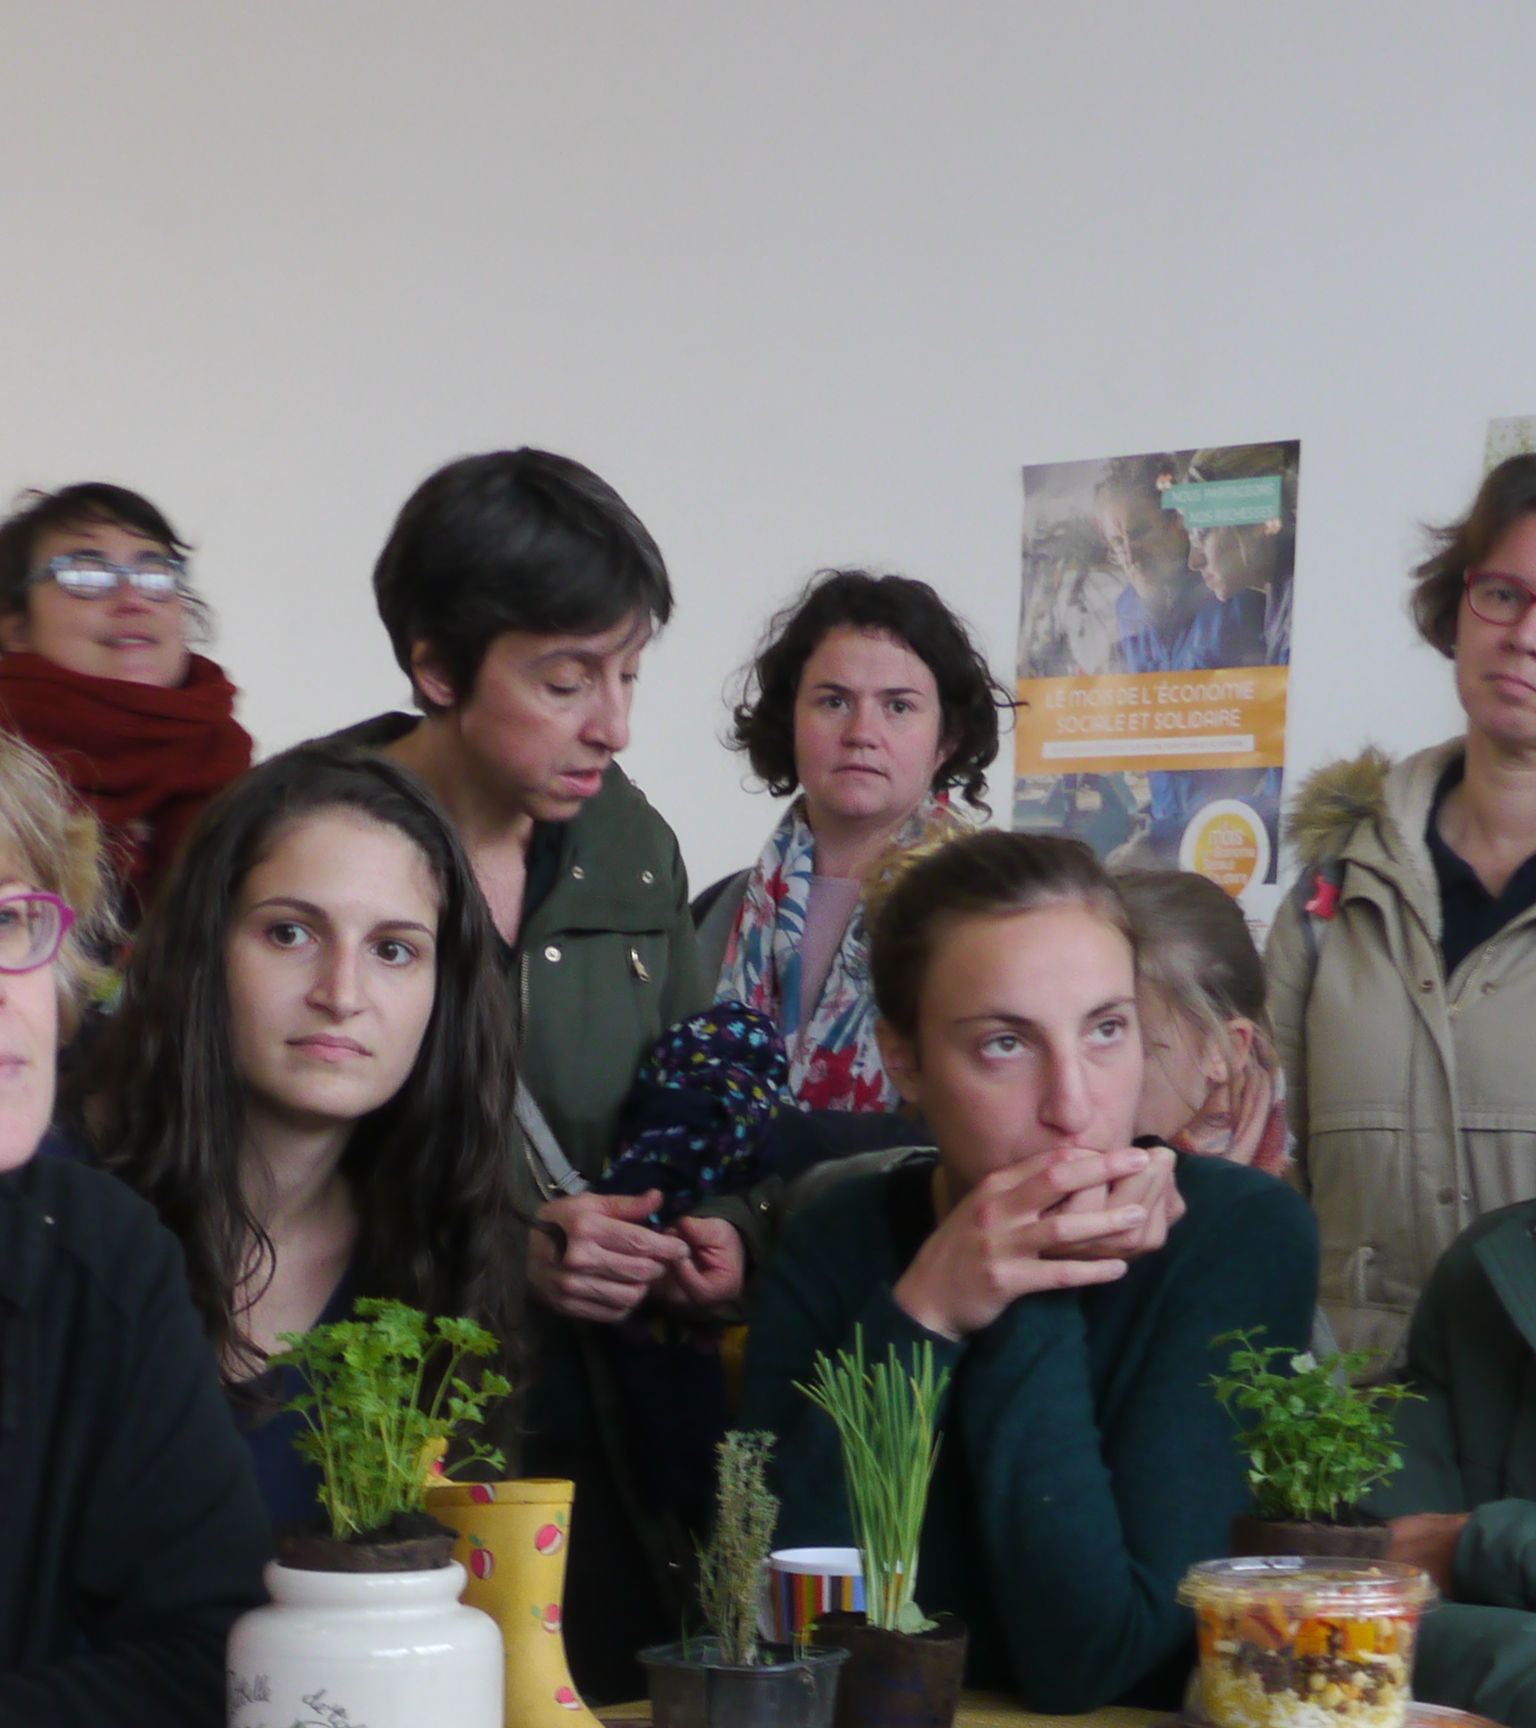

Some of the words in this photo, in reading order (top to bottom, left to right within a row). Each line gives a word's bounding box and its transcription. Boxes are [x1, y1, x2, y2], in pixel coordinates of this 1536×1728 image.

[1045, 690, 1067, 709] LE
[1116, 686, 1140, 706] DE
[1056, 713, 1126, 734] SOCIALE
[1128, 712, 1152, 732] ET
[1154, 708, 1242, 731] SOLIDAIRE
